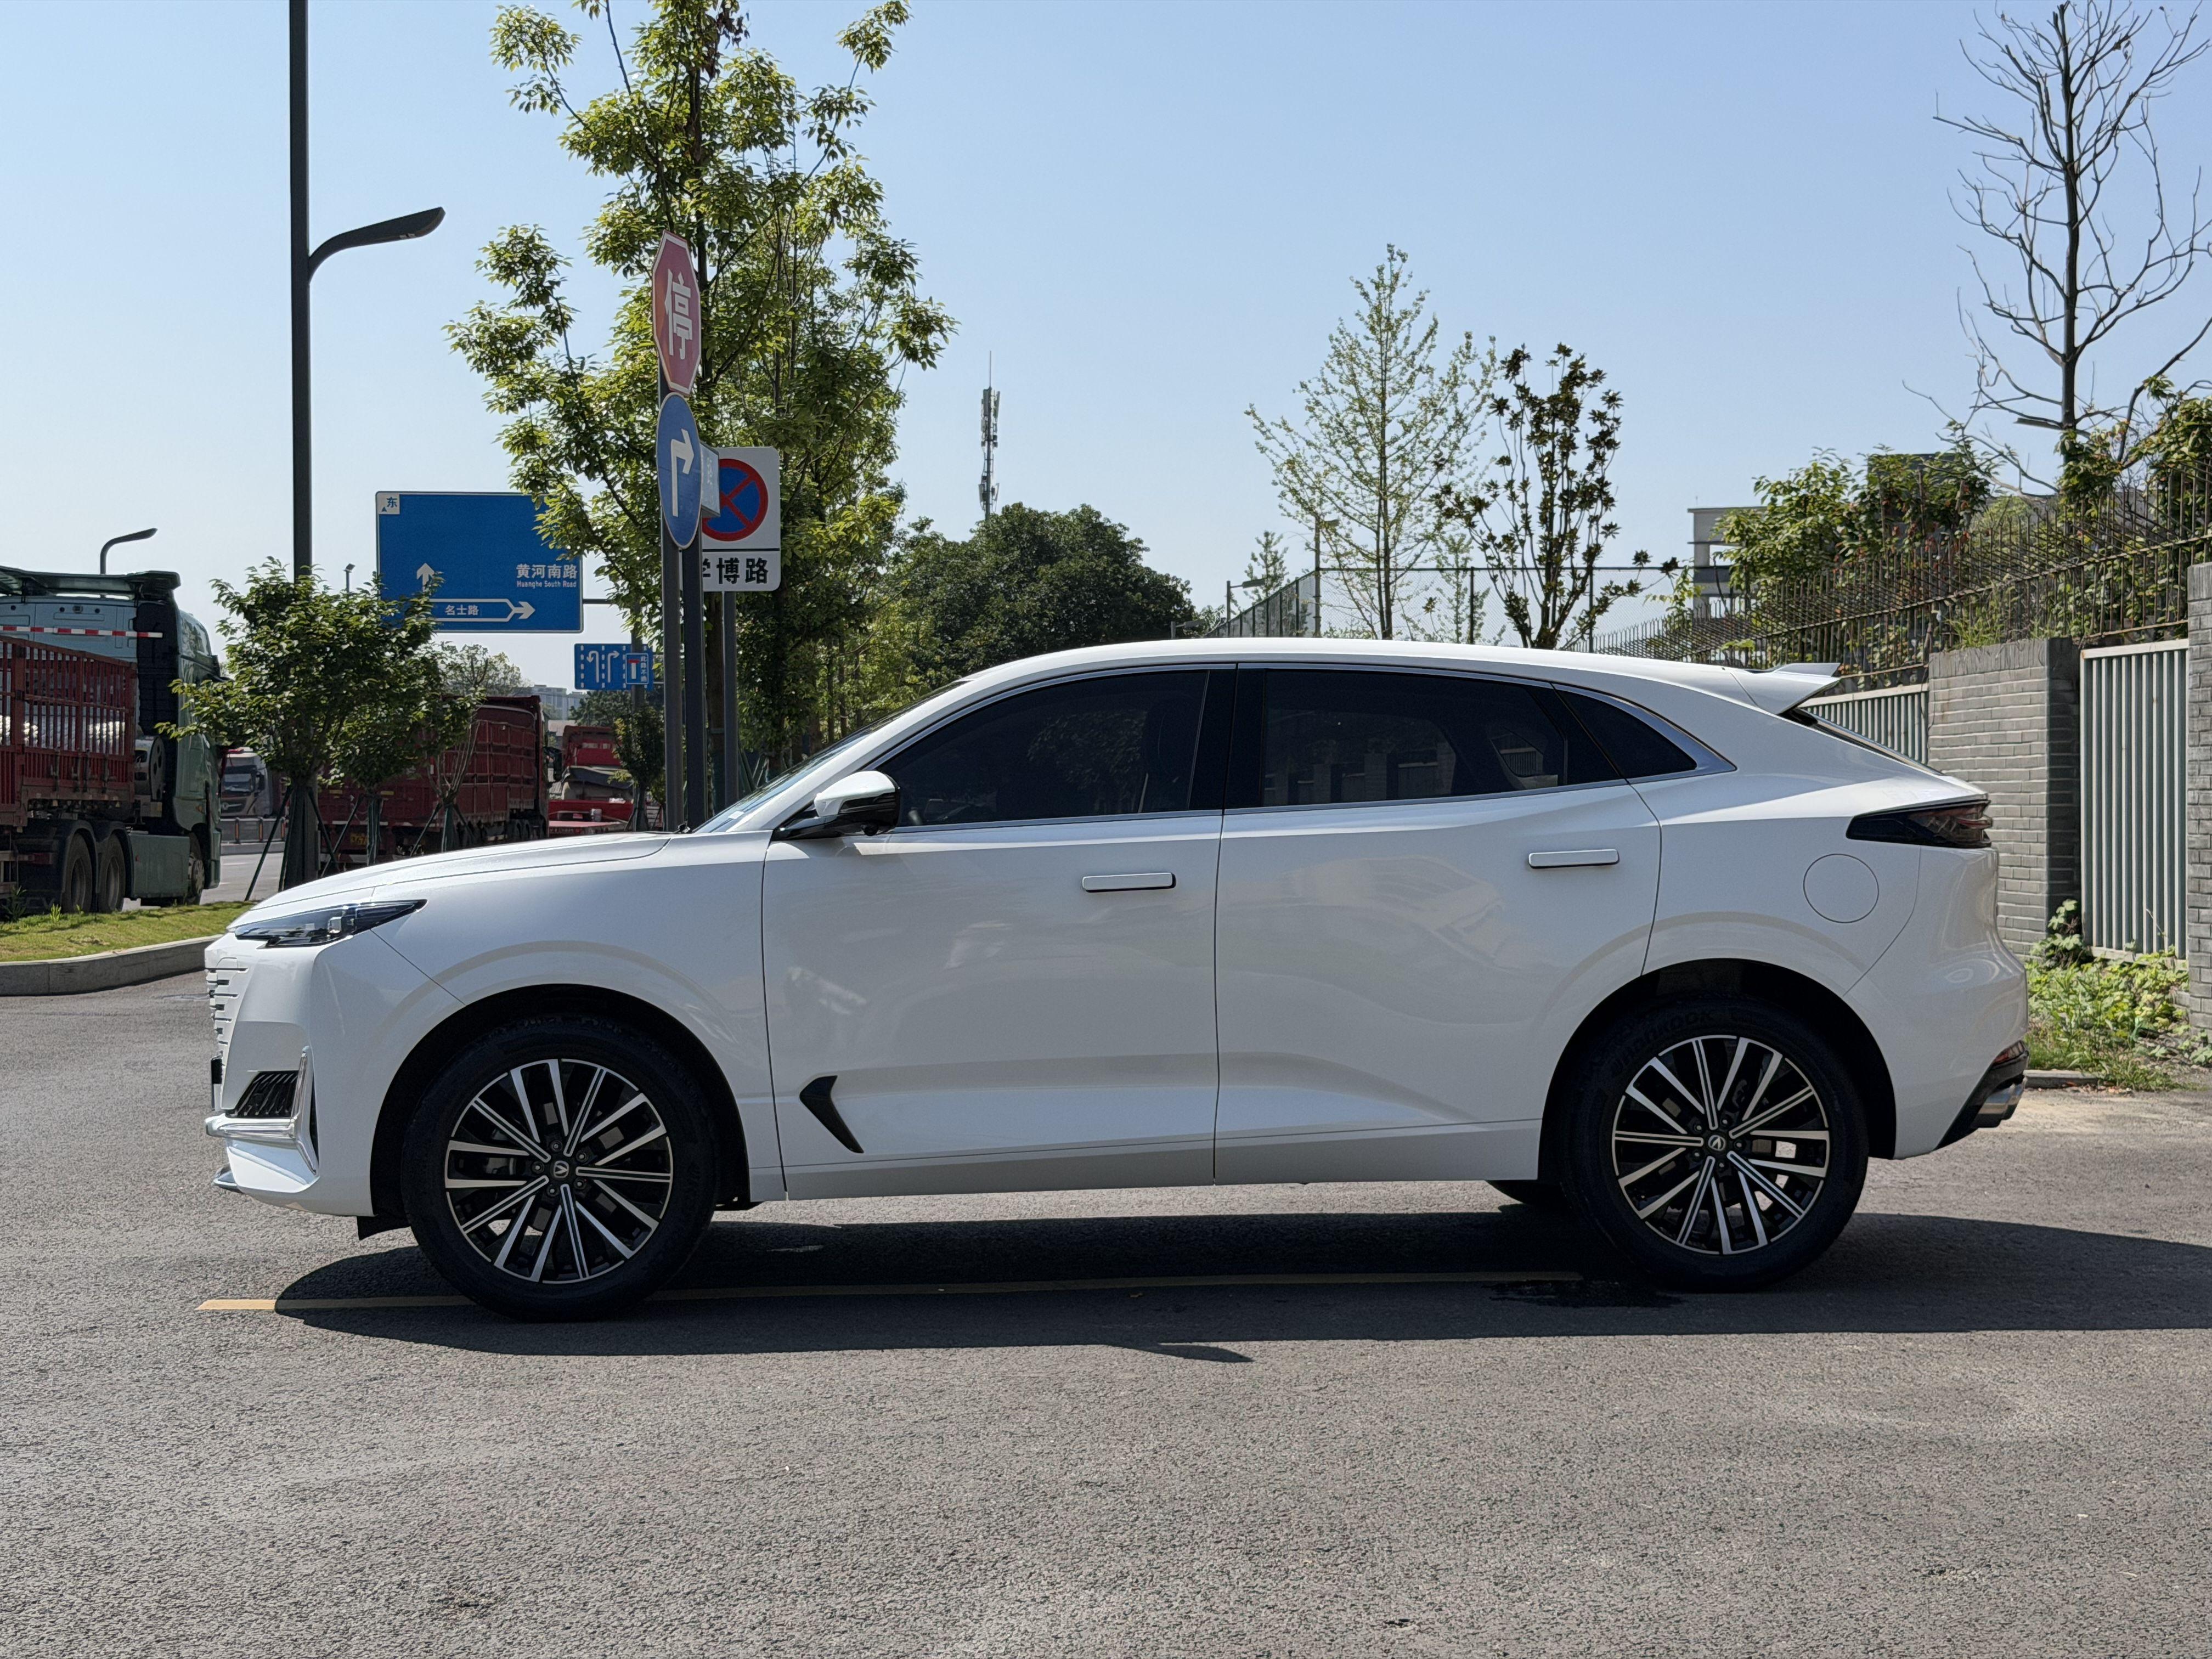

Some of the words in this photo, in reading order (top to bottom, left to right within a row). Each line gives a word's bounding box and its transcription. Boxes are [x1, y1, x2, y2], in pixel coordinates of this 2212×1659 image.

[664, 269, 692, 359] 停
[386, 496, 397, 508] 东
[516, 563, 577, 579] 黄河南路
[517, 580, 543, 589] Huanghe
[445, 605, 479, 616] 名士路
